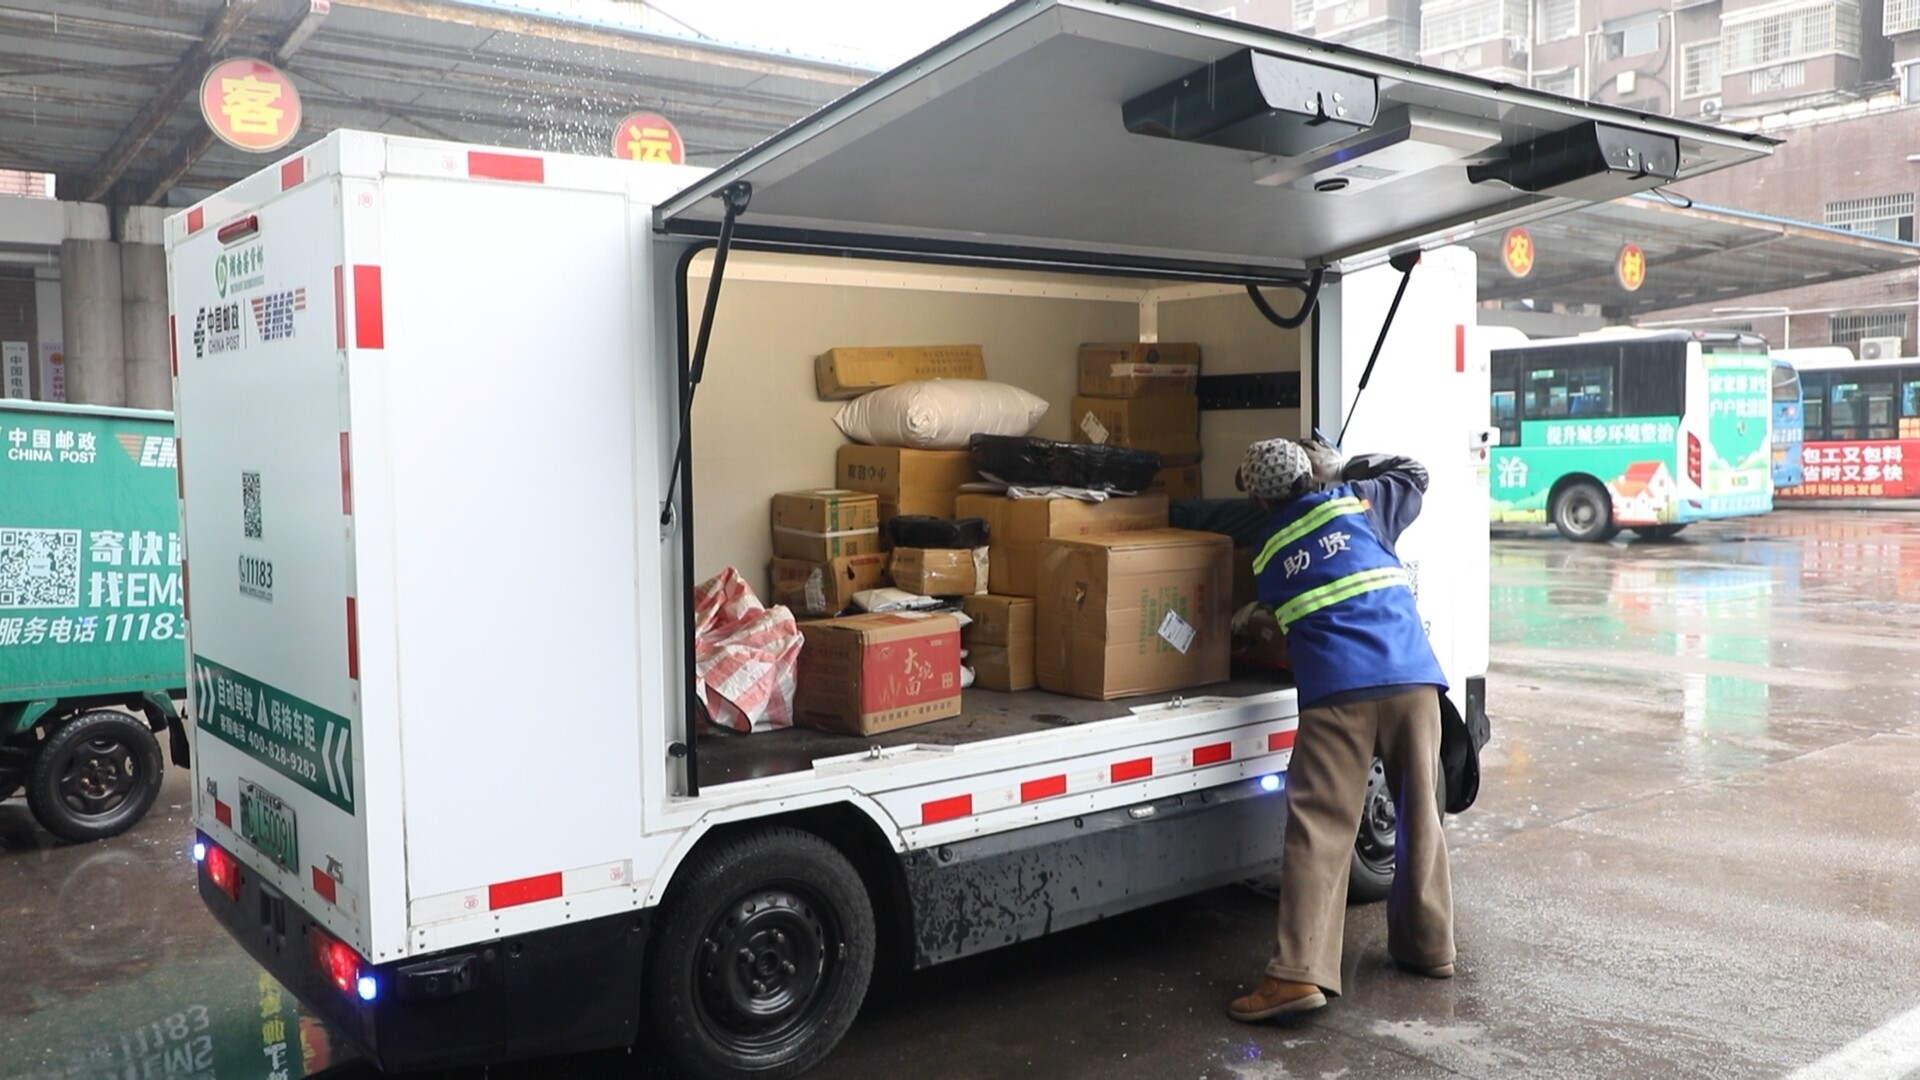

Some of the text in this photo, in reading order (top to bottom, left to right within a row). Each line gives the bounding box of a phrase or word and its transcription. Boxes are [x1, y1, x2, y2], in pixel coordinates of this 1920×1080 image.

[221, 75, 283, 135] 客
[628, 125, 672, 164] 运
[1509, 235, 1530, 268] 农
[1624, 251, 1642, 284] 村
[207, 301, 240, 335] 中国邮政
[263, 290, 295, 341] EMS
[208, 334, 240, 354] CHINA POST
[10, 355, 24, 398] 中国电信
[9, 427, 97, 450] 中国邮政
[1546, 423, 1674, 445] 提升城乡环境整治
[8, 448, 97, 464] CHINA POST
[1497, 457, 1528, 489] 治
[1283, 531, 1351, 578] 助贤
[88, 571, 184, 607] 找EM
[246, 558, 273, 589] 11183
[0, 617, 98, 646] 服务电话
[904, 648, 934, 697] 大碗面
[217, 675, 316, 752] 自动驾驶 保持车距
[248, 730, 317, 782] 400-828-9282
